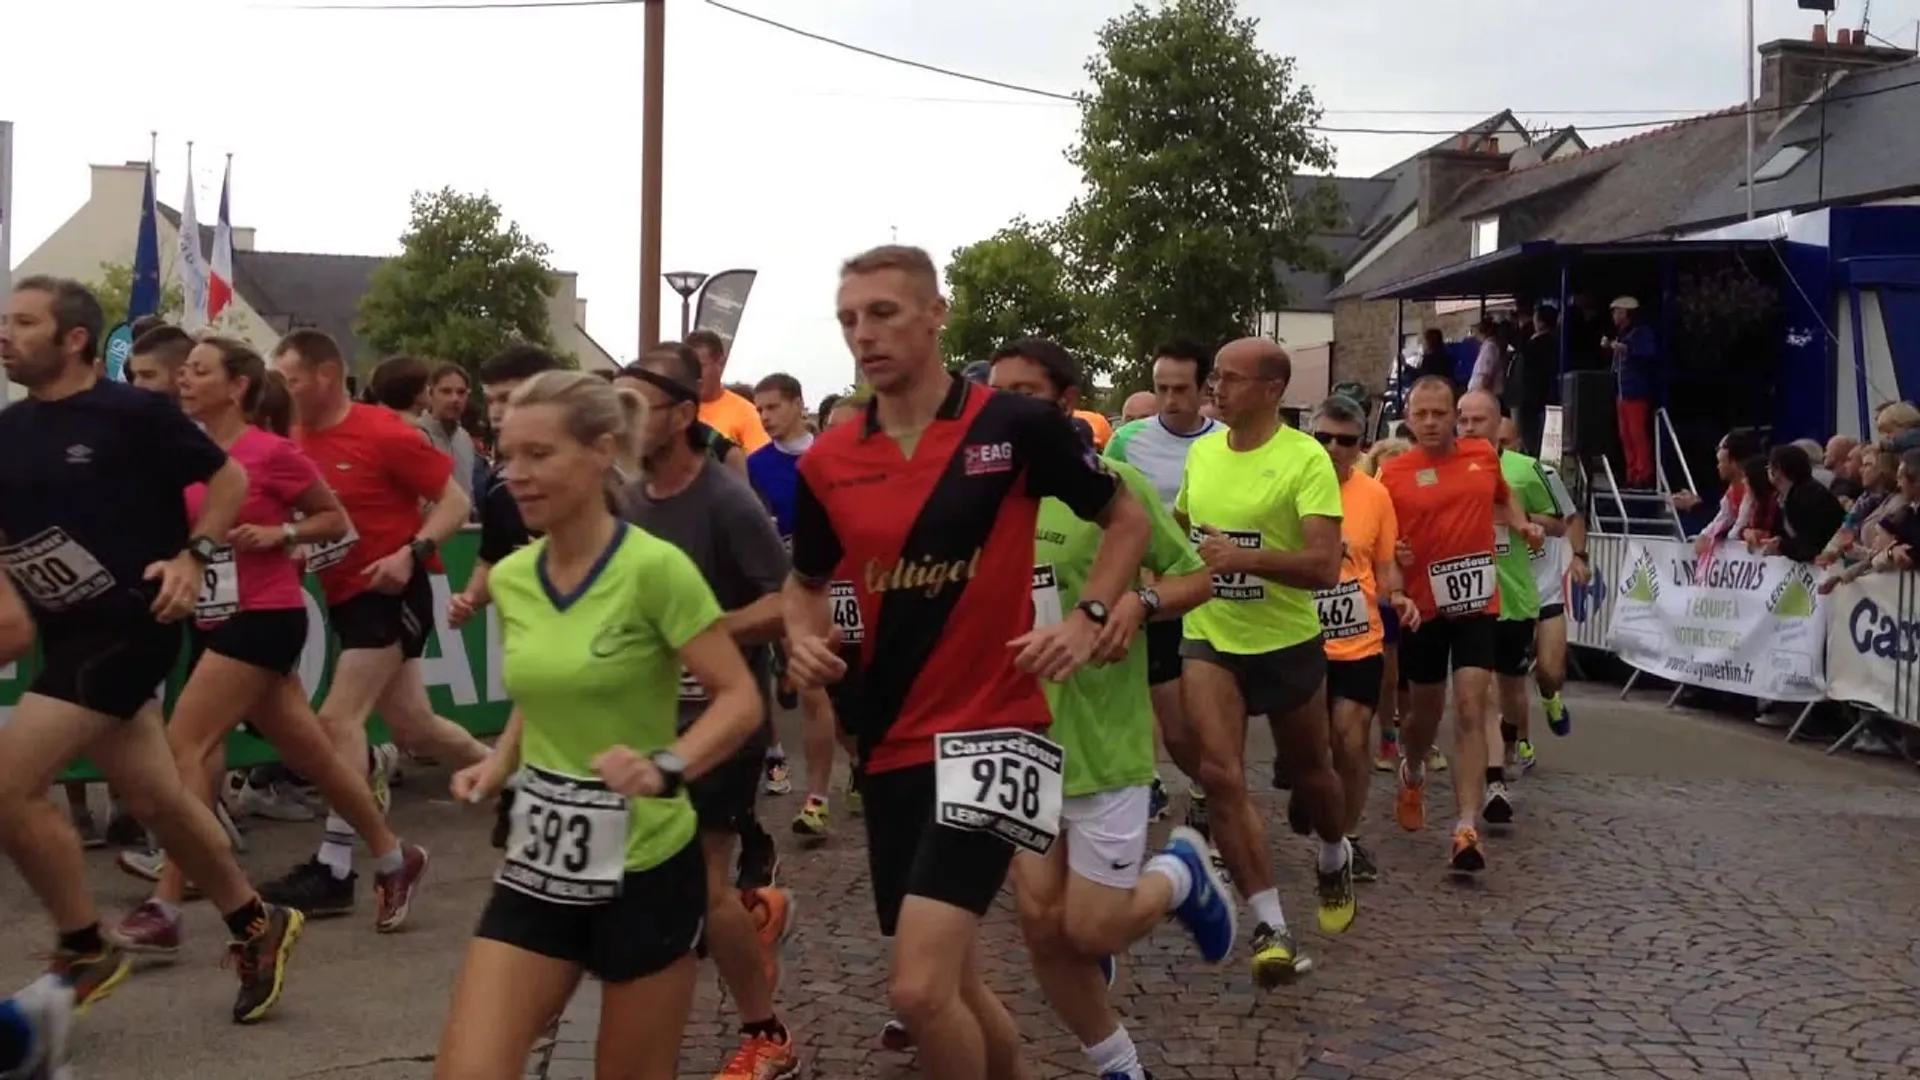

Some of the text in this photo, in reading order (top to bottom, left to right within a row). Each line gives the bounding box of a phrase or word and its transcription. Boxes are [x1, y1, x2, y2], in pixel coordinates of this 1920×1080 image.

[981, 440, 1012, 462] EAG
[1431, 555, 1492, 574] Carrefour
[1446, 569, 1484, 601] 897
[834, 599, 859, 628] 48
[1317, 597, 1356, 627] 462
[943, 735, 1061, 769] Carrefour
[972, 758, 1049, 820] 958
[523, 804, 592, 873] 593
